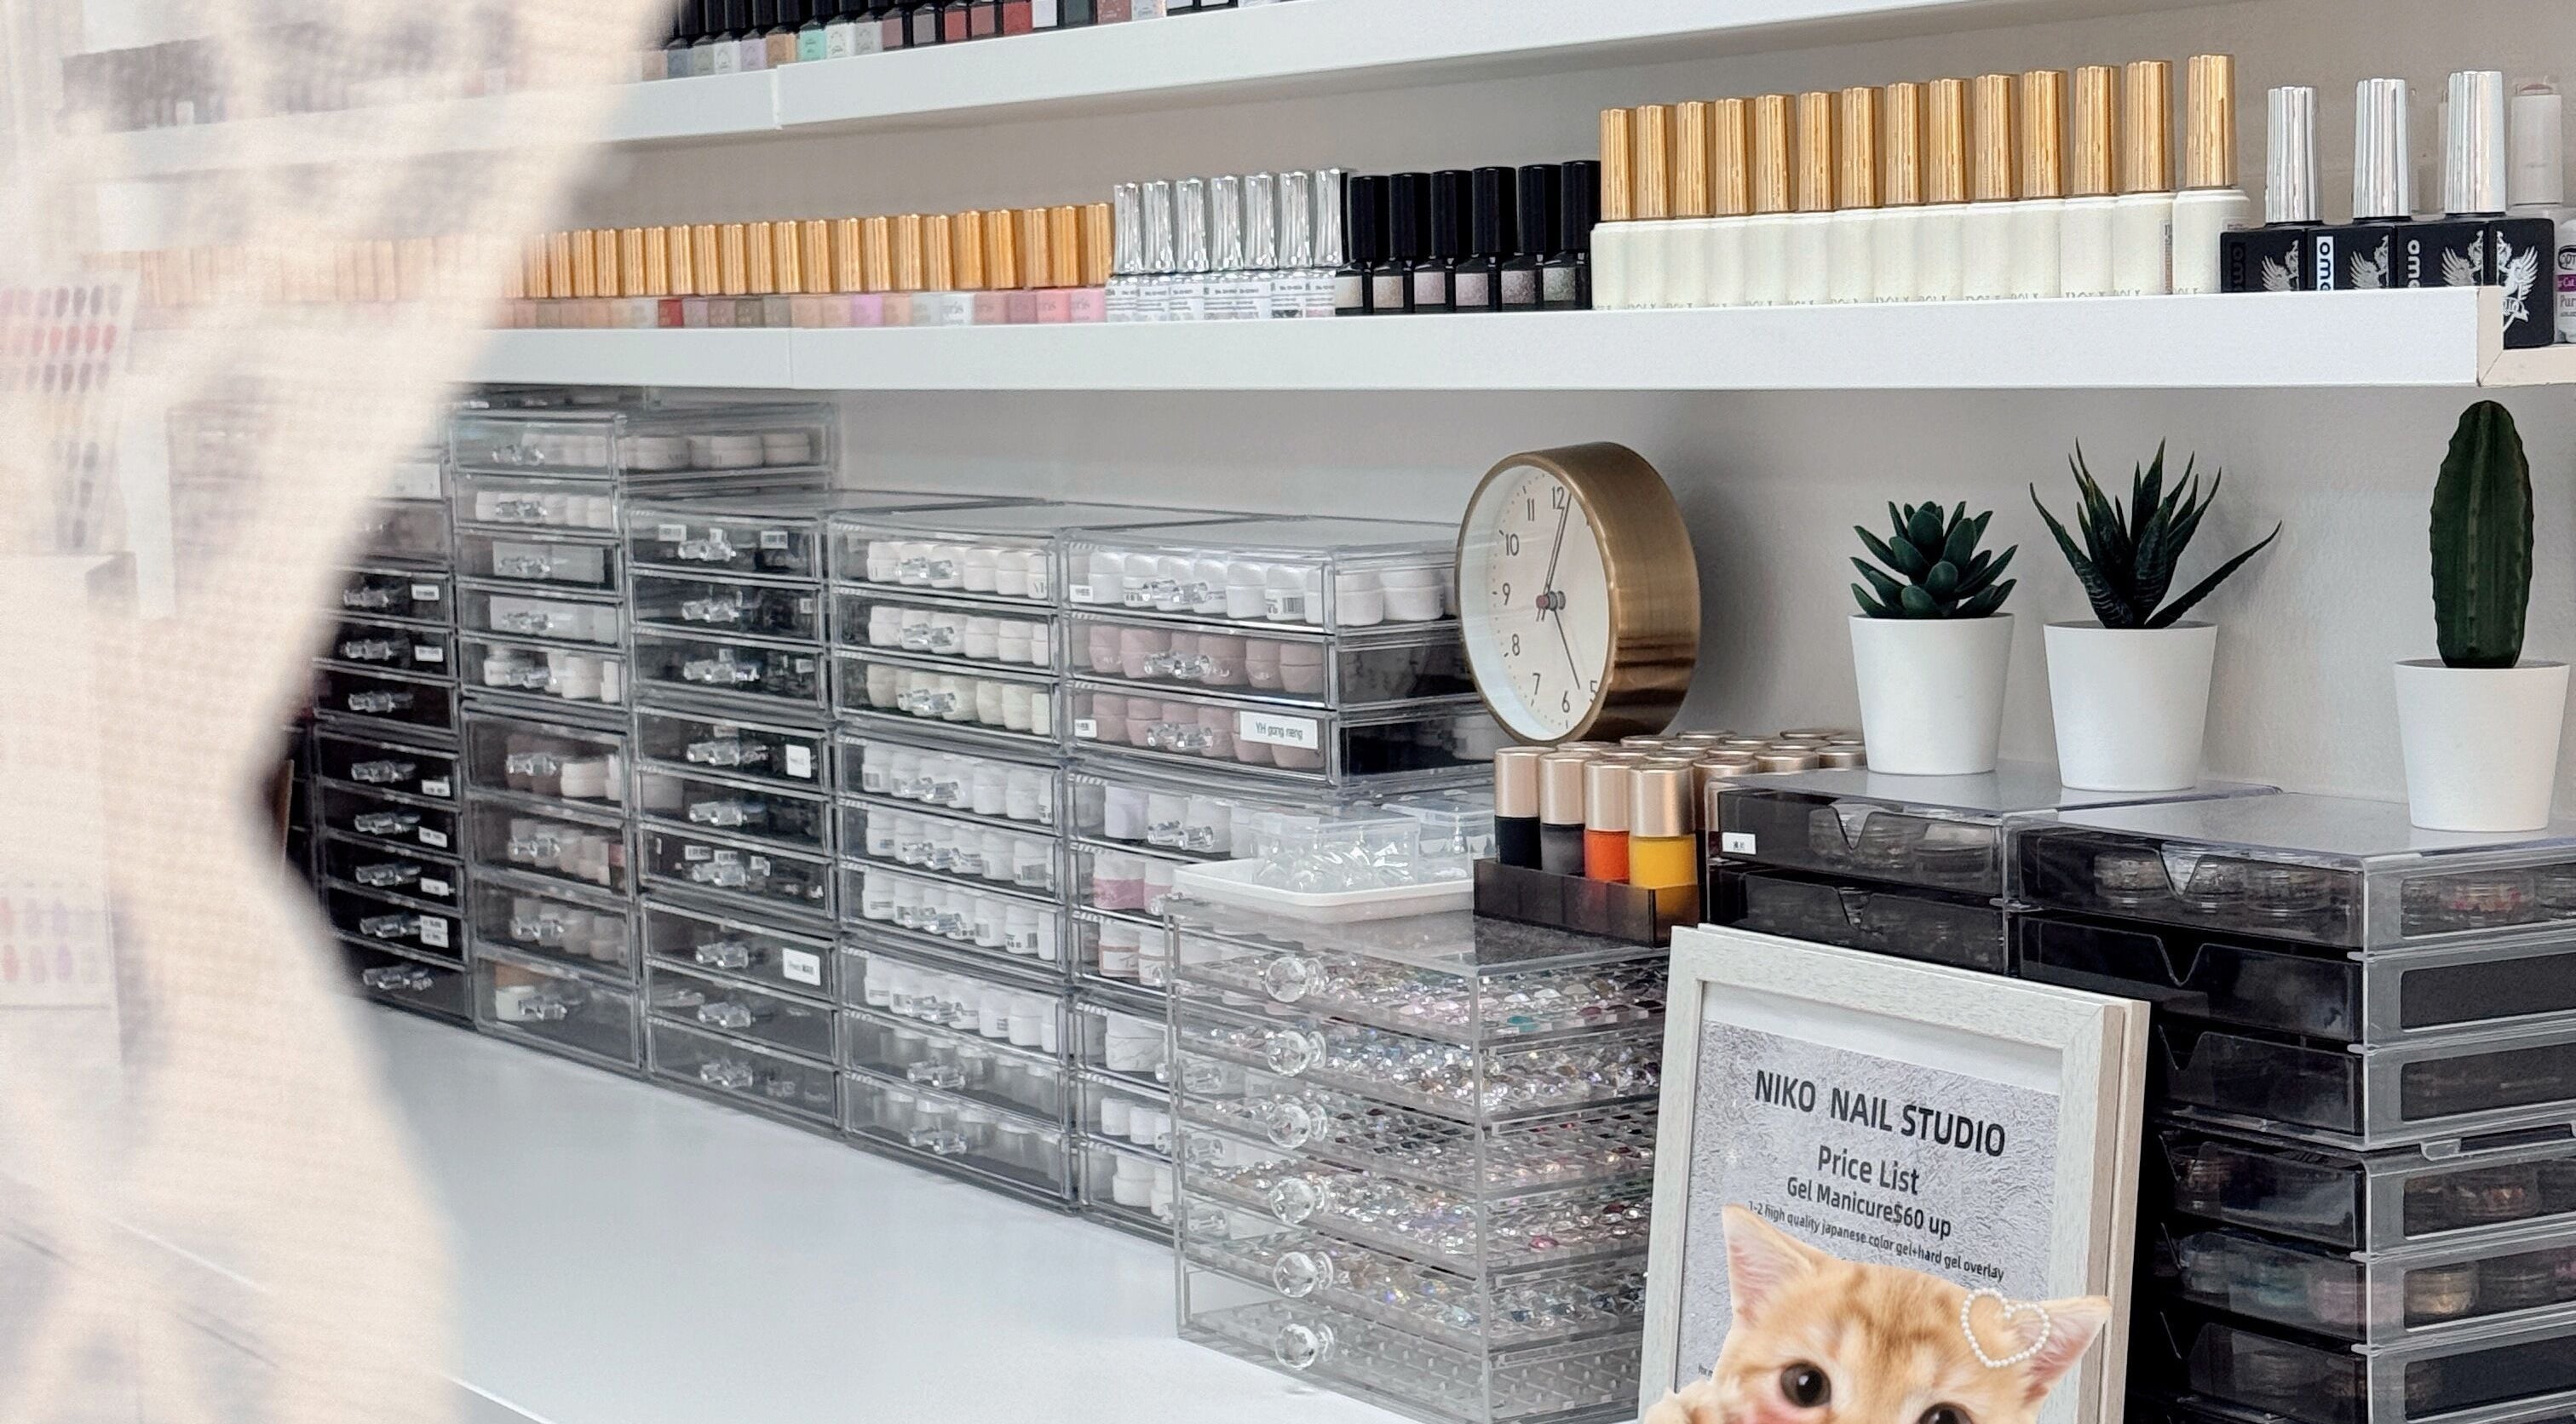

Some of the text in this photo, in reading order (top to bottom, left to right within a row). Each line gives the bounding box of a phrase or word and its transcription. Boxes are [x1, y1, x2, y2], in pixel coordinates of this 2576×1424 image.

[1527, 497, 1535, 522] 11
[1551, 485, 1566, 510] 12
[1504, 533, 1520, 556] 10
[1502, 582, 1511, 606] 9
[1511, 634, 1521, 657] 8
[1532, 672, 1541, 696] 7
[1590, 680, 1598, 704] 5
[1561, 691, 1571, 714] 6
[1755, 1068, 2005, 1157] NIKO NAIL STUDIO
[1818, 1145, 1920, 1196] Price List
[1787, 1176, 1952, 1241] Gel Manicure$60 up
[1748, 1200, 2005, 1283] 1-2 high quality japanese color gel+hard gel overlay
